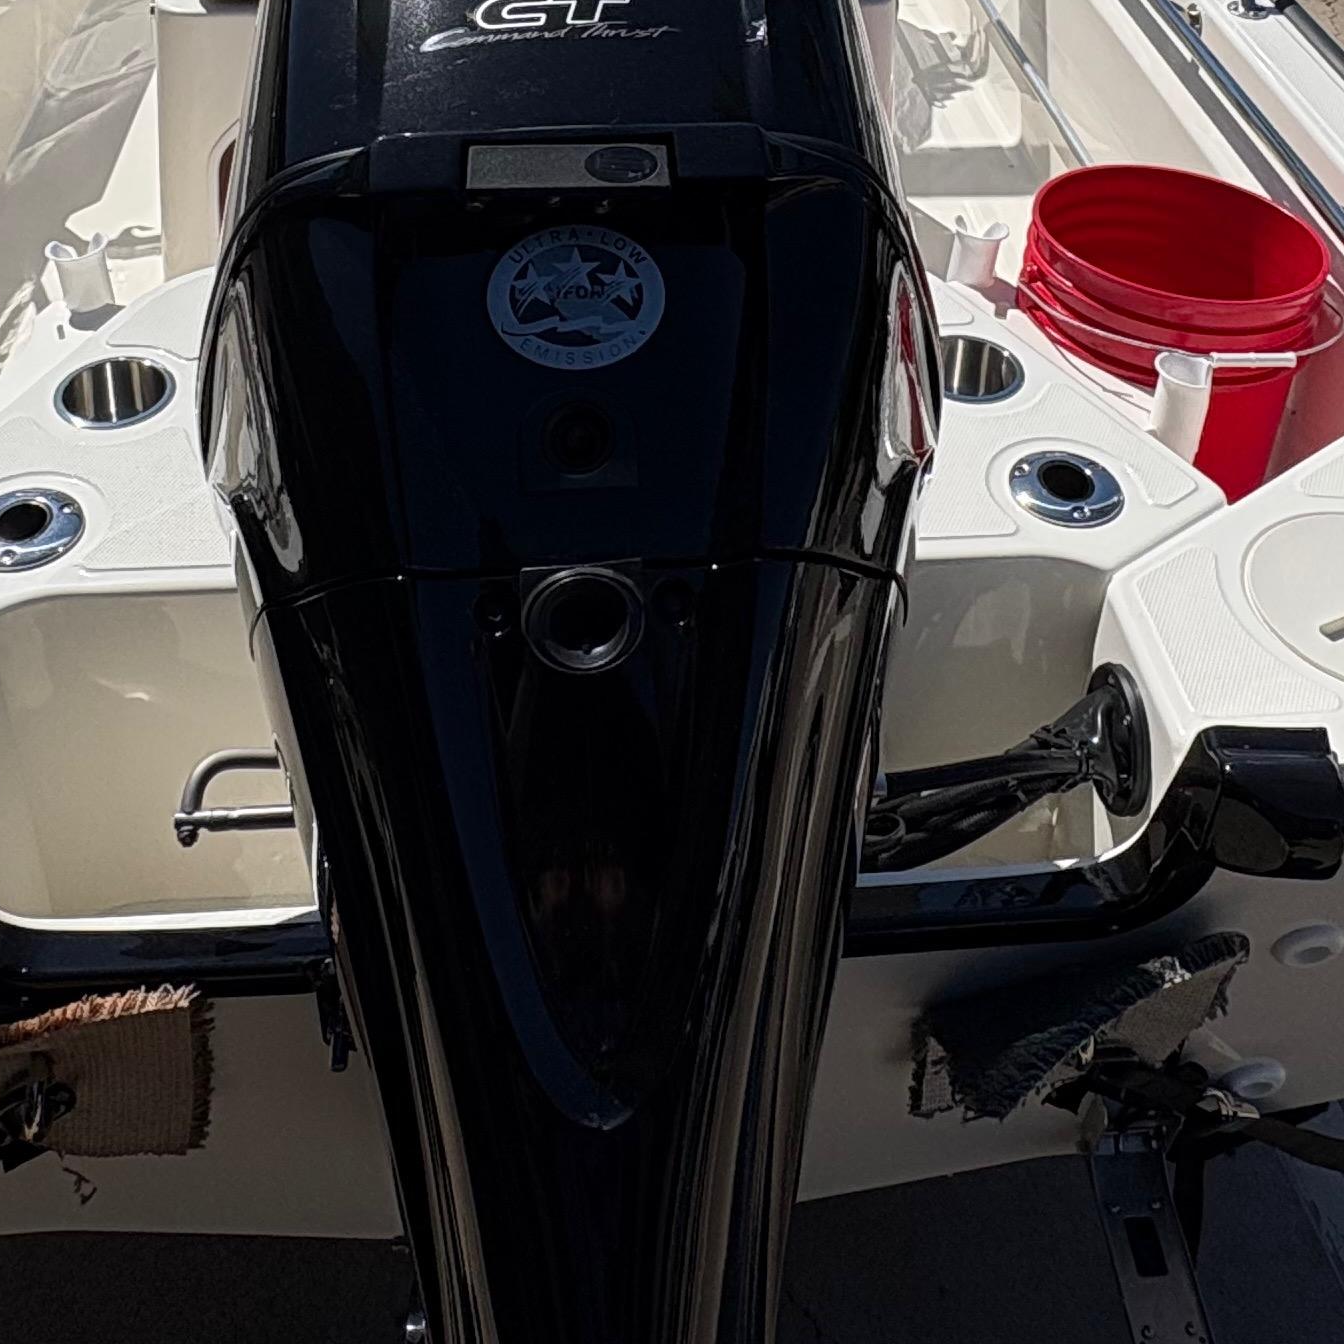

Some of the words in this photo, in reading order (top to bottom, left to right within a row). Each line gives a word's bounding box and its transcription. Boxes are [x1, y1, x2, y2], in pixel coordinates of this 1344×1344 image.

[419, 26, 571, 53] Command
[570, 21, 682, 39] Thrust
[508, 227, 582, 265] ULTRA
[599, 230, 649, 265] LOW
[519, 336, 638, 366] EMISSION
